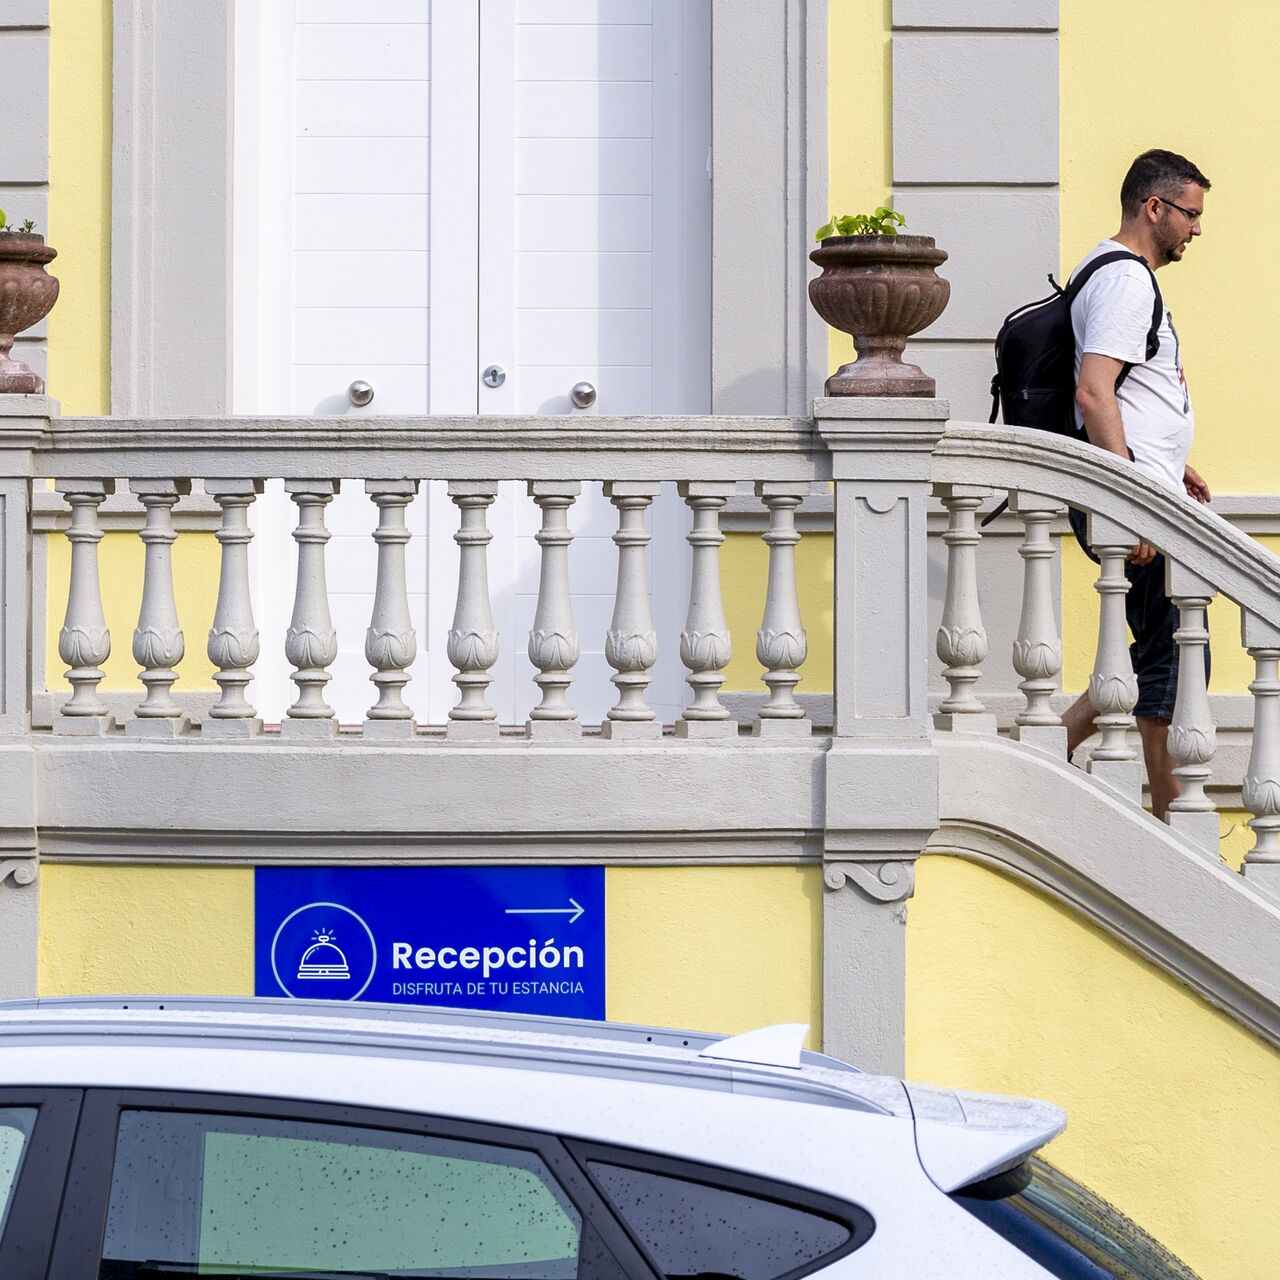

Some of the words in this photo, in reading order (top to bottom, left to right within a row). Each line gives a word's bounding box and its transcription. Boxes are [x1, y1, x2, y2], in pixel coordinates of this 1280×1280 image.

[392, 937, 584, 979] Recepción
[392, 981, 463, 996] DISFRUTA
[466, 981, 486, 996] DE
[489, 981, 508, 996] TU
[512, 980, 585, 995] ESTANCIA
